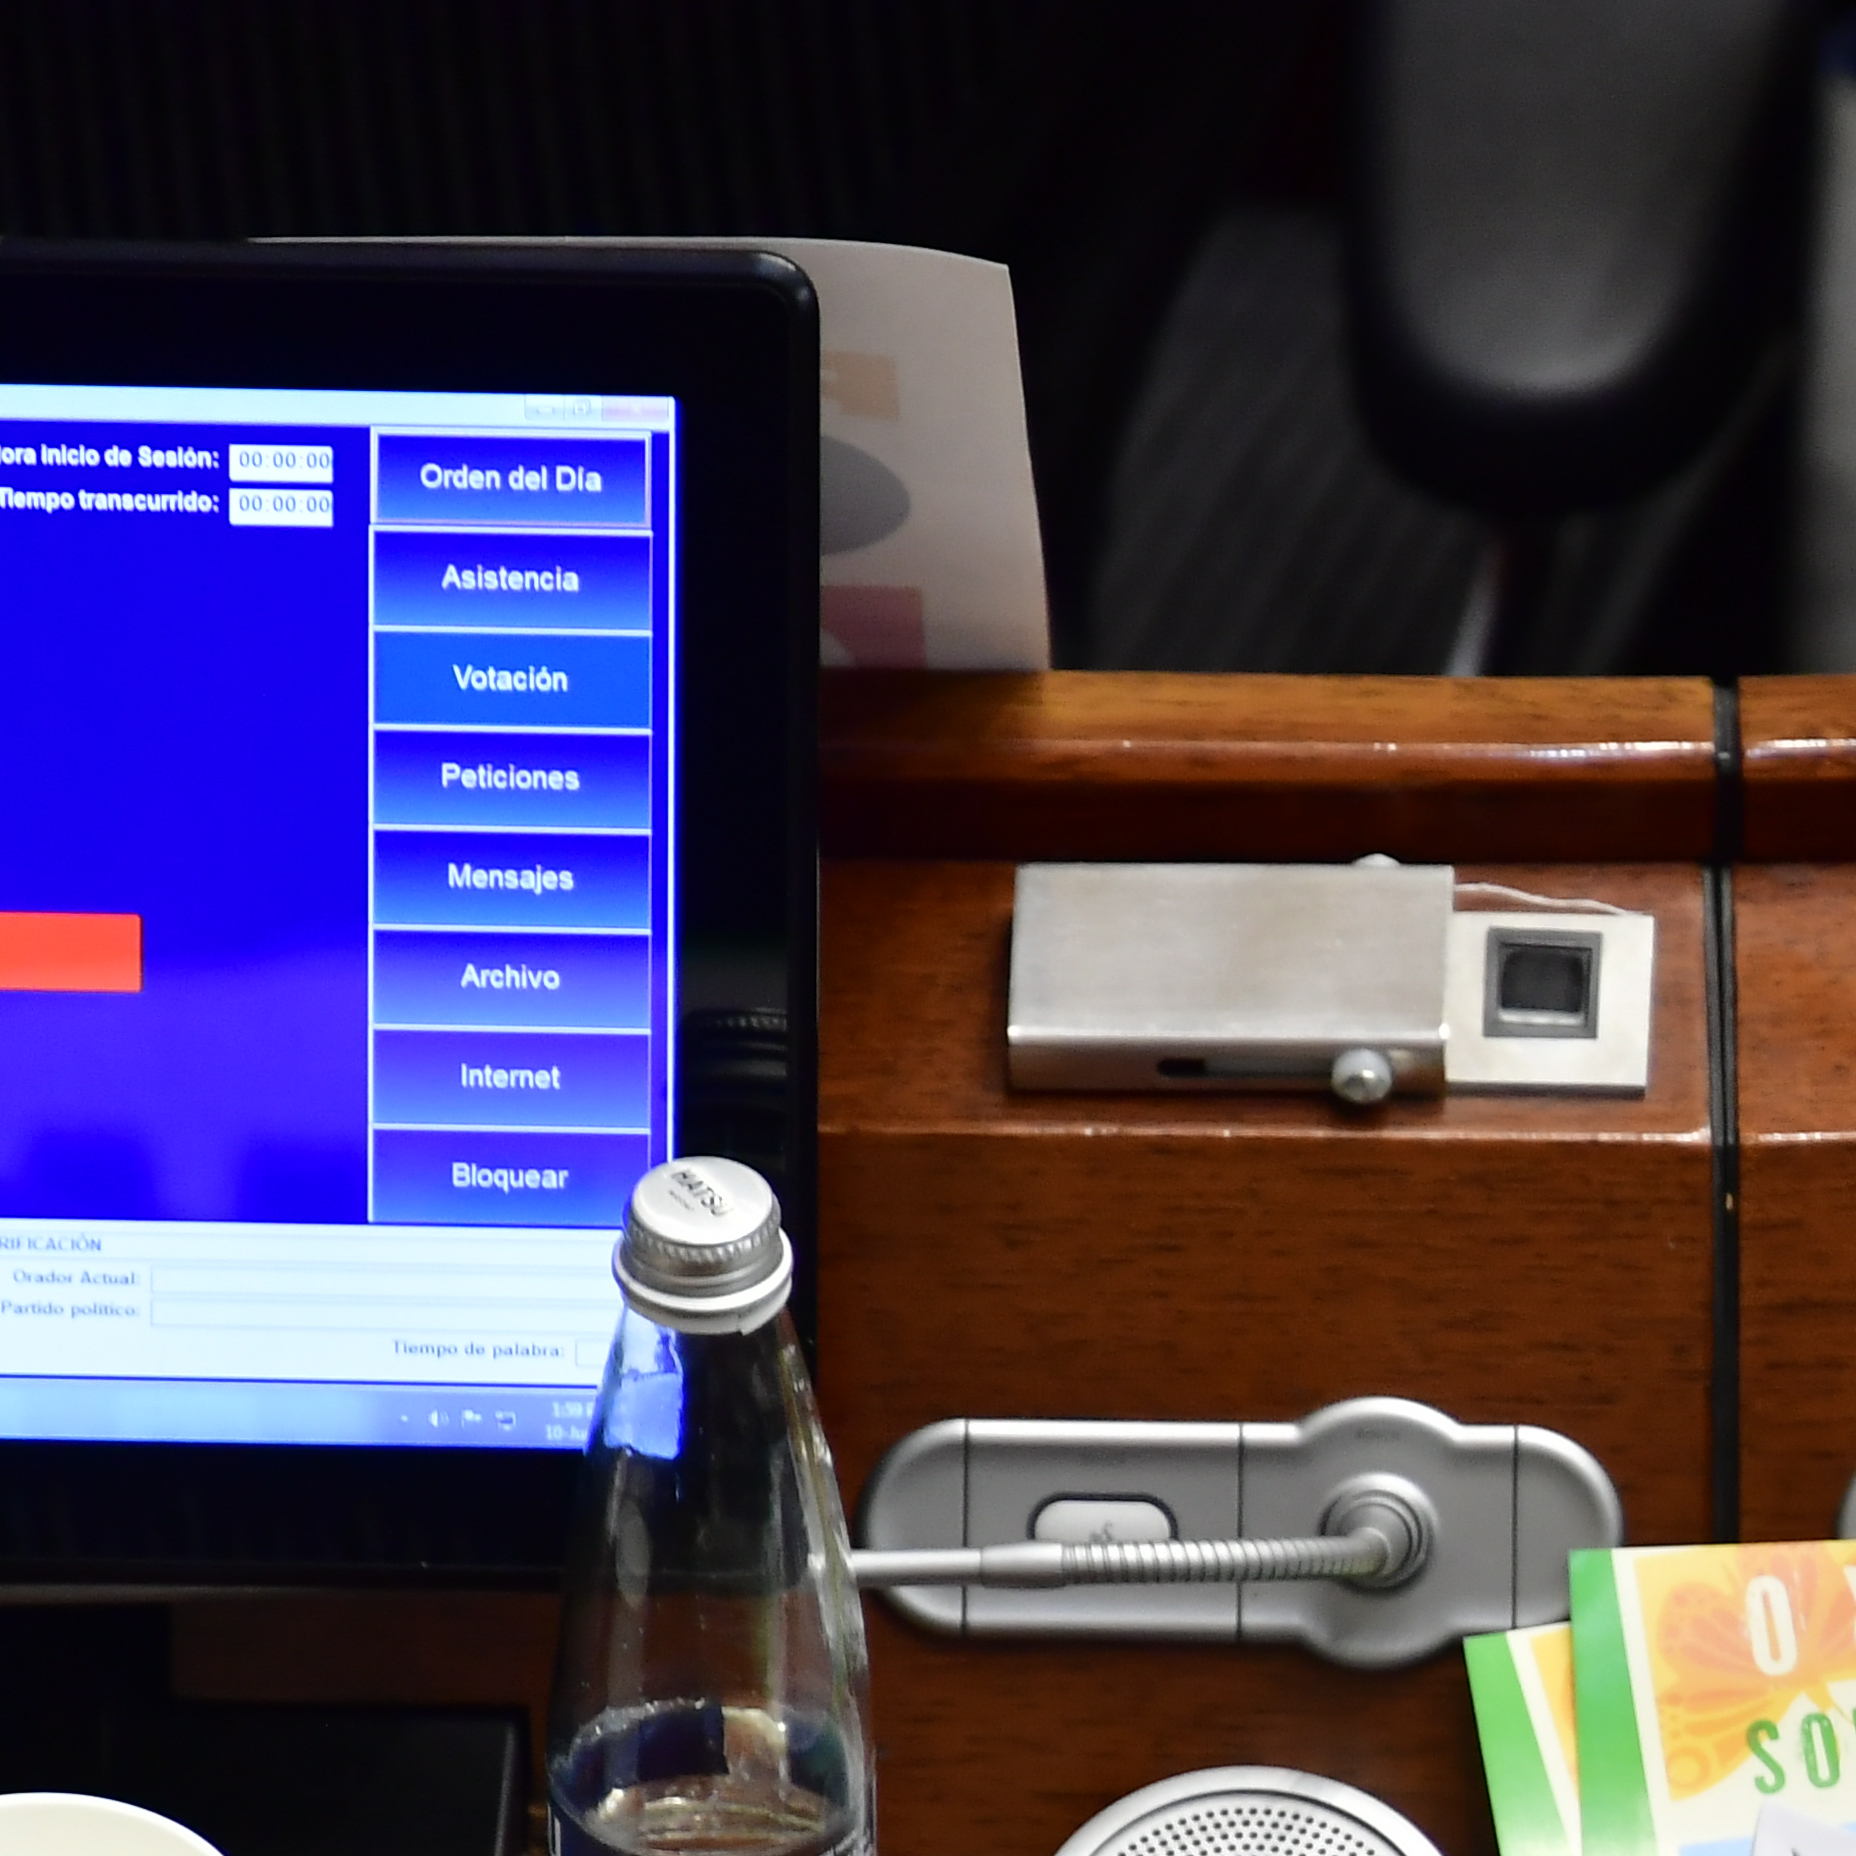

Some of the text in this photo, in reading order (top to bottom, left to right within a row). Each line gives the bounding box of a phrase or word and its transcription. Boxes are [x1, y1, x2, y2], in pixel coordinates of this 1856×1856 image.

[104, 444, 132, 468] de
[137, 445, 220, 470] Sesión:
[238, 450, 331, 470] 00:00:00
[419, 462, 603, 494] Orden del Día
[0, 486, 220, 514] Tiempo transcurrido:
[238, 495, 331, 514] 00:00:00
[441, 563, 580, 594] Asistencia
[452, 663, 569, 694] Votación
[440, 762, 581, 793] Peticiones
[447, 862, 575, 896] Mensajes
[460, 962, 562, 992] Archivo
[460, 1063, 562, 1091] Internet
[451, 1162, 570, 1193] Bloquear
[12, 1268, 73, 1284] Orador
[0, 1299, 65, 1316] Partido
[393, 1339, 458, 1359] Tiempo
[464, 1341, 486, 1356] de
